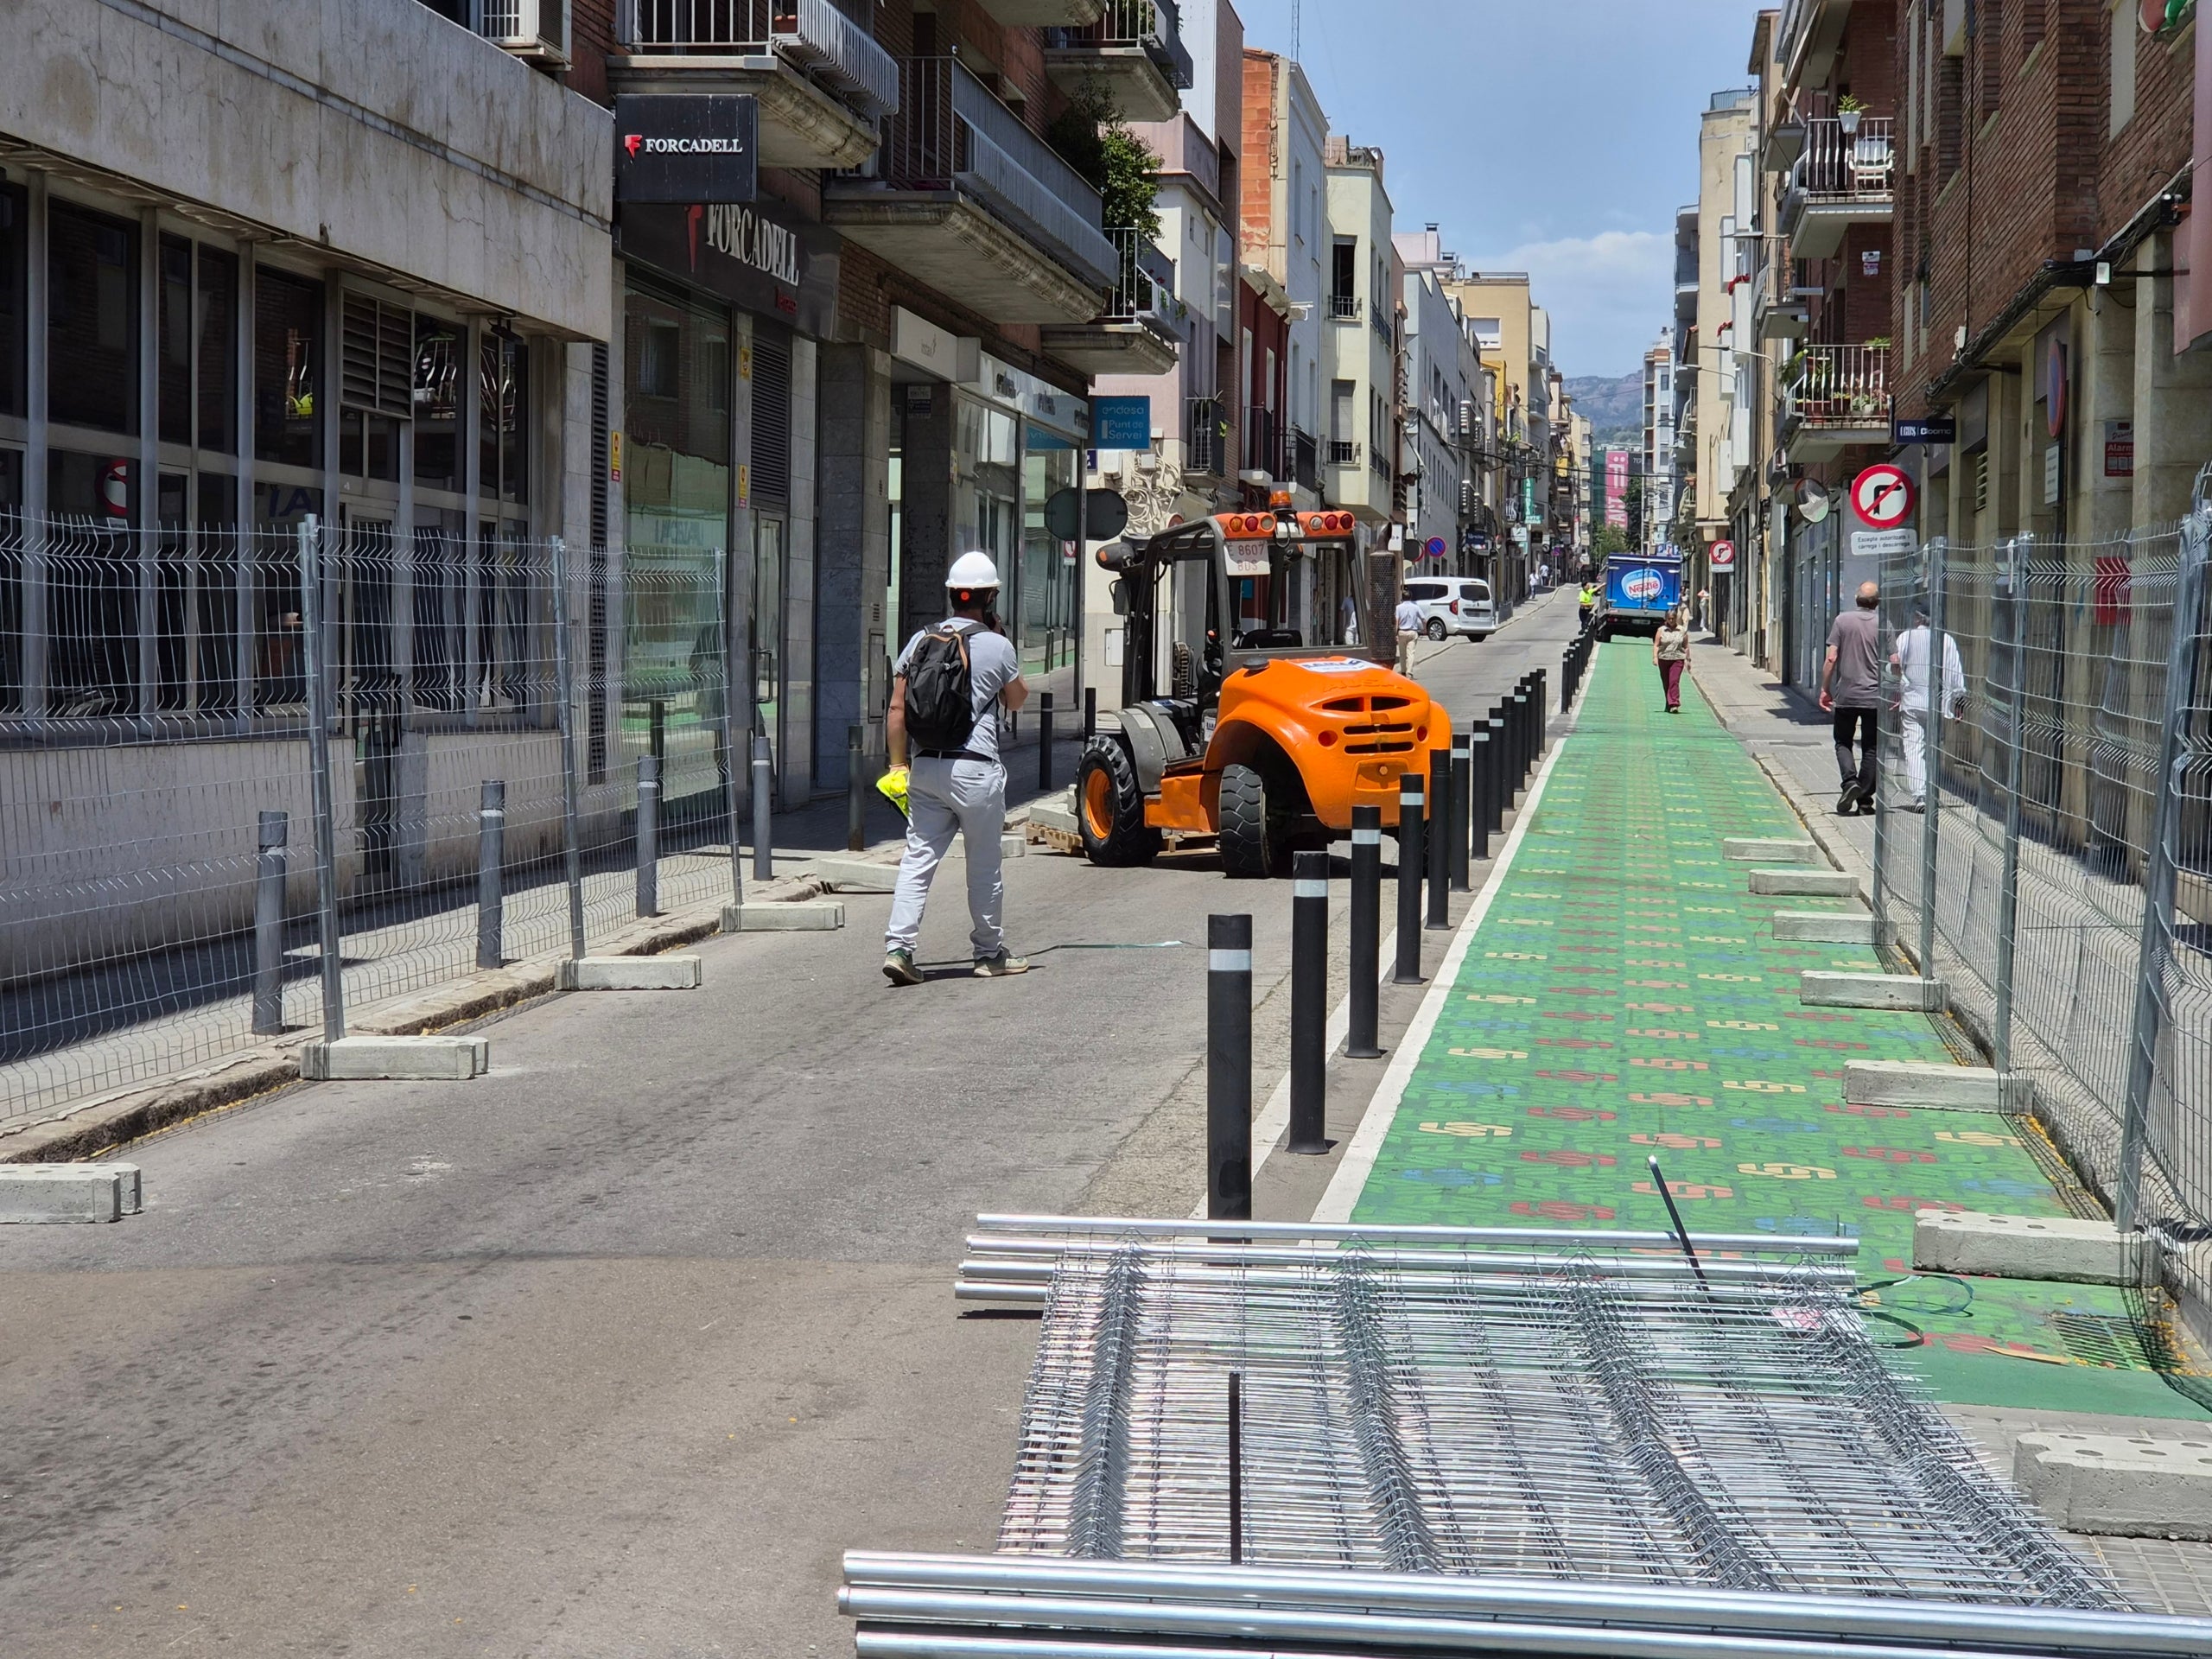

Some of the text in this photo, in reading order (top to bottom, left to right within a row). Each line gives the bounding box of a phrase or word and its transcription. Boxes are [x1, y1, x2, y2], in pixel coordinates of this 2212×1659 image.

[645, 138, 743, 153] FORCADELL
[705, 204, 799, 287] FORCADELL
[1102, 404, 1145, 415] endesa
[1109, 420, 1131, 429] Punt
[1109, 429, 1142, 440] Servei
[1237, 543, 1265, 556] 8607
[1628, 580, 1659, 594] Nestlé
